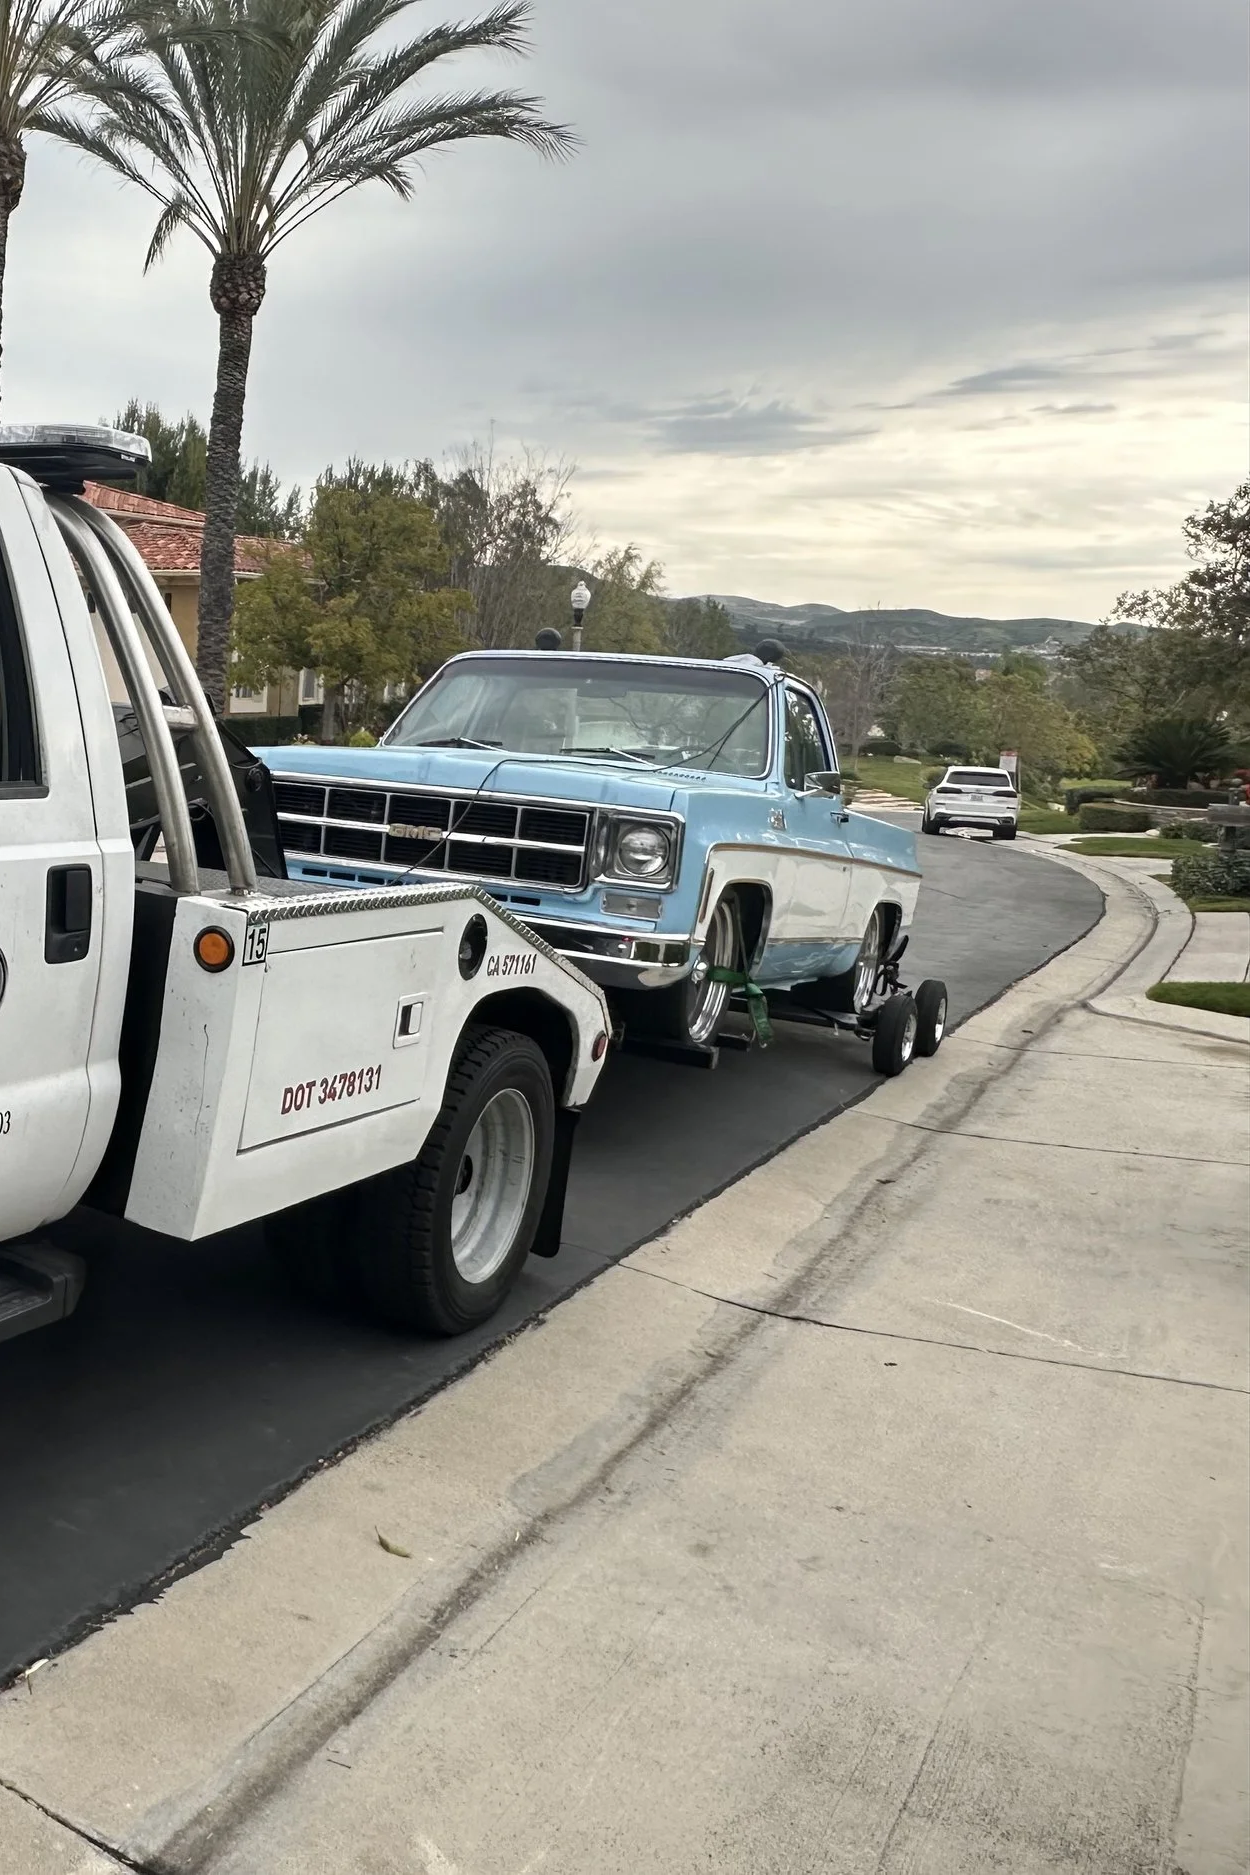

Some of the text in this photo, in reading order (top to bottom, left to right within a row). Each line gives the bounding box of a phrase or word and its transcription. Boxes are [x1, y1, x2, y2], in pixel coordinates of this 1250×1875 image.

[248, 927, 266, 959] 15
[486, 953, 537, 977] CA 571161
[281, 1064, 382, 1115] DOT 3478131
